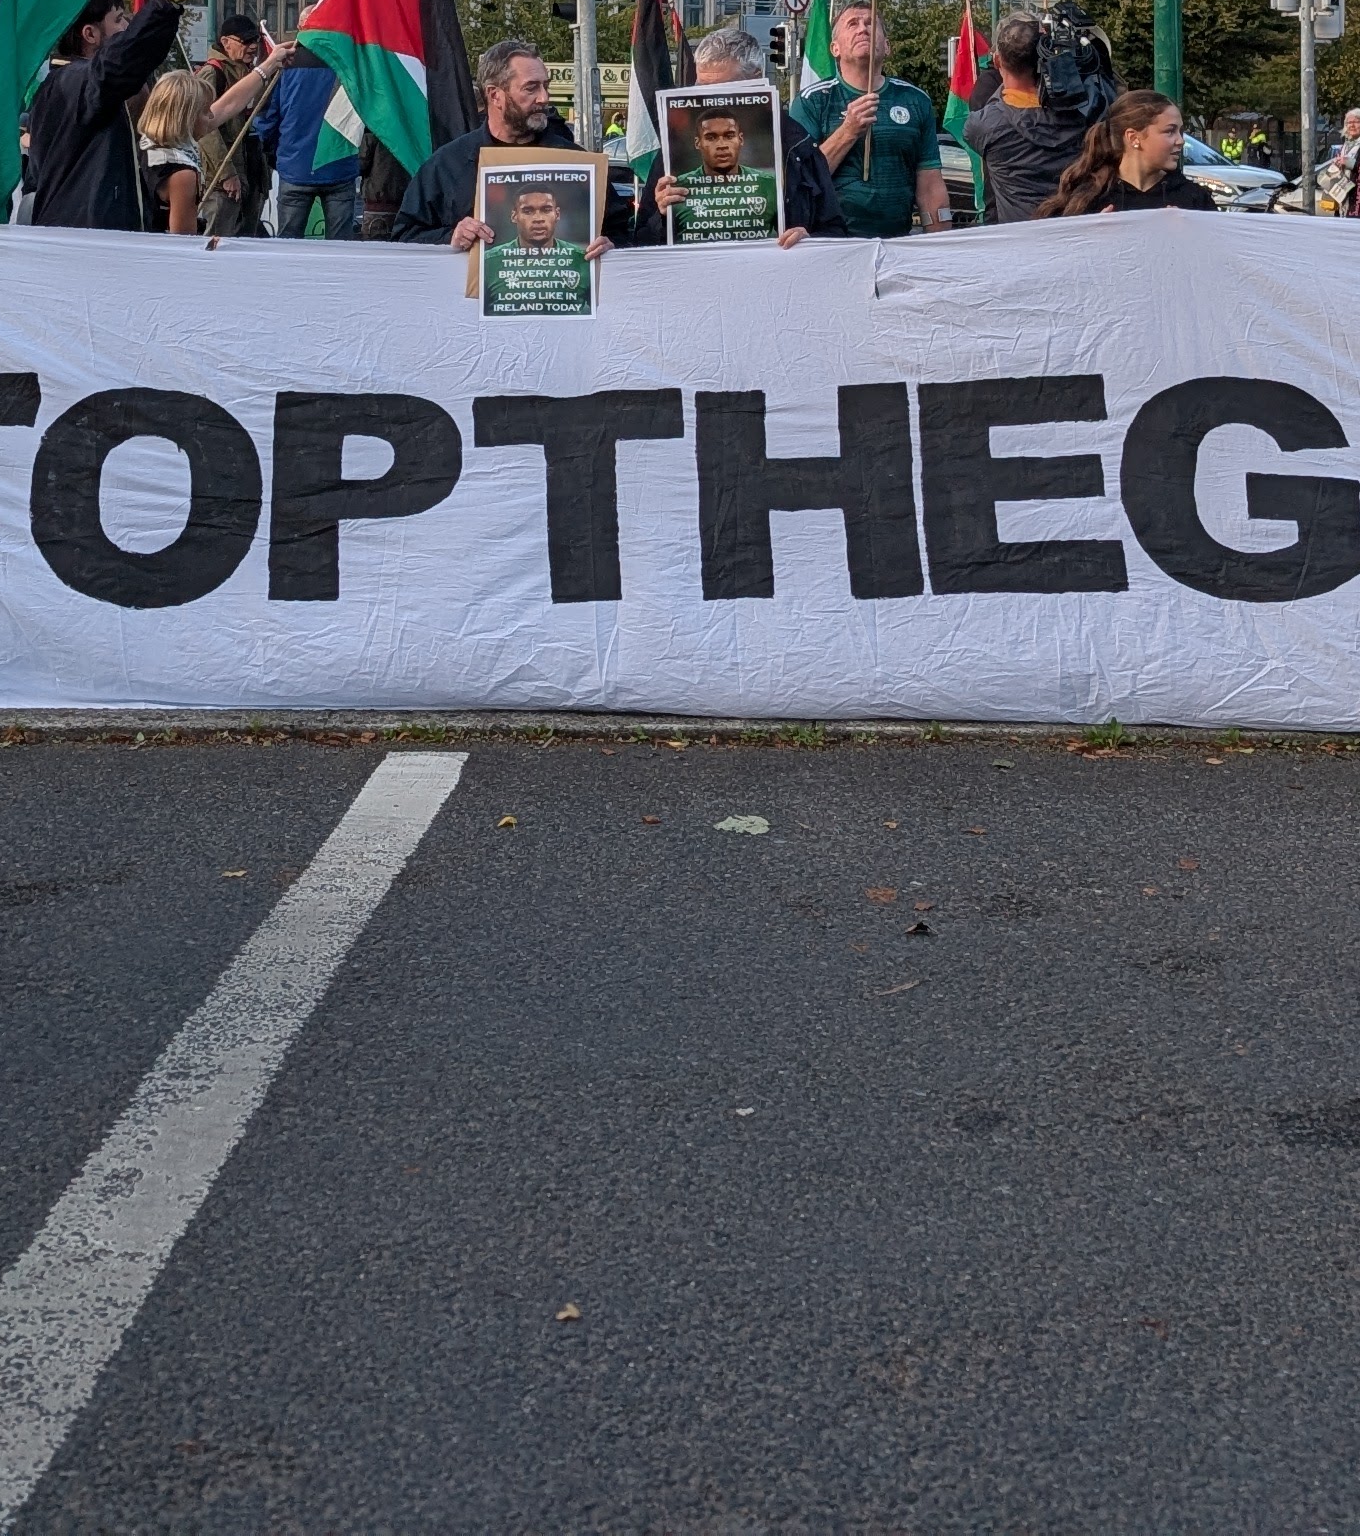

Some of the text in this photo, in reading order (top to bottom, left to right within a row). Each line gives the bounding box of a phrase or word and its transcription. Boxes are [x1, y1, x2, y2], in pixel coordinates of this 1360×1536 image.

[603, 68, 618, 83] &
[669, 95, 770, 109] REAL IRISH HERO
[488, 173, 588, 184] REAL IRISH HERO
[687, 173, 759, 184] THIS IS WHAT
[688, 185, 759, 195] THE FACE OF
[686, 196, 763, 206] BRAVERY AND
[696, 208, 753, 217] INTEGRITY
[686, 219, 764, 229] LOOKS LIKE IN
[682, 230, 770, 241] IRELAND TODAY
[502, 248, 527, 256] THIS
[540, 247, 574, 255] WHAT
[502, 258, 573, 267] THE FACE OF
[498, 269, 577, 279] BRAVERY AND
[509, 280, 567, 289] INTEGRITY
[498, 292, 577, 301] LOOKS LIKE IN
[493, 303, 582, 312] IRELAND TODAY
